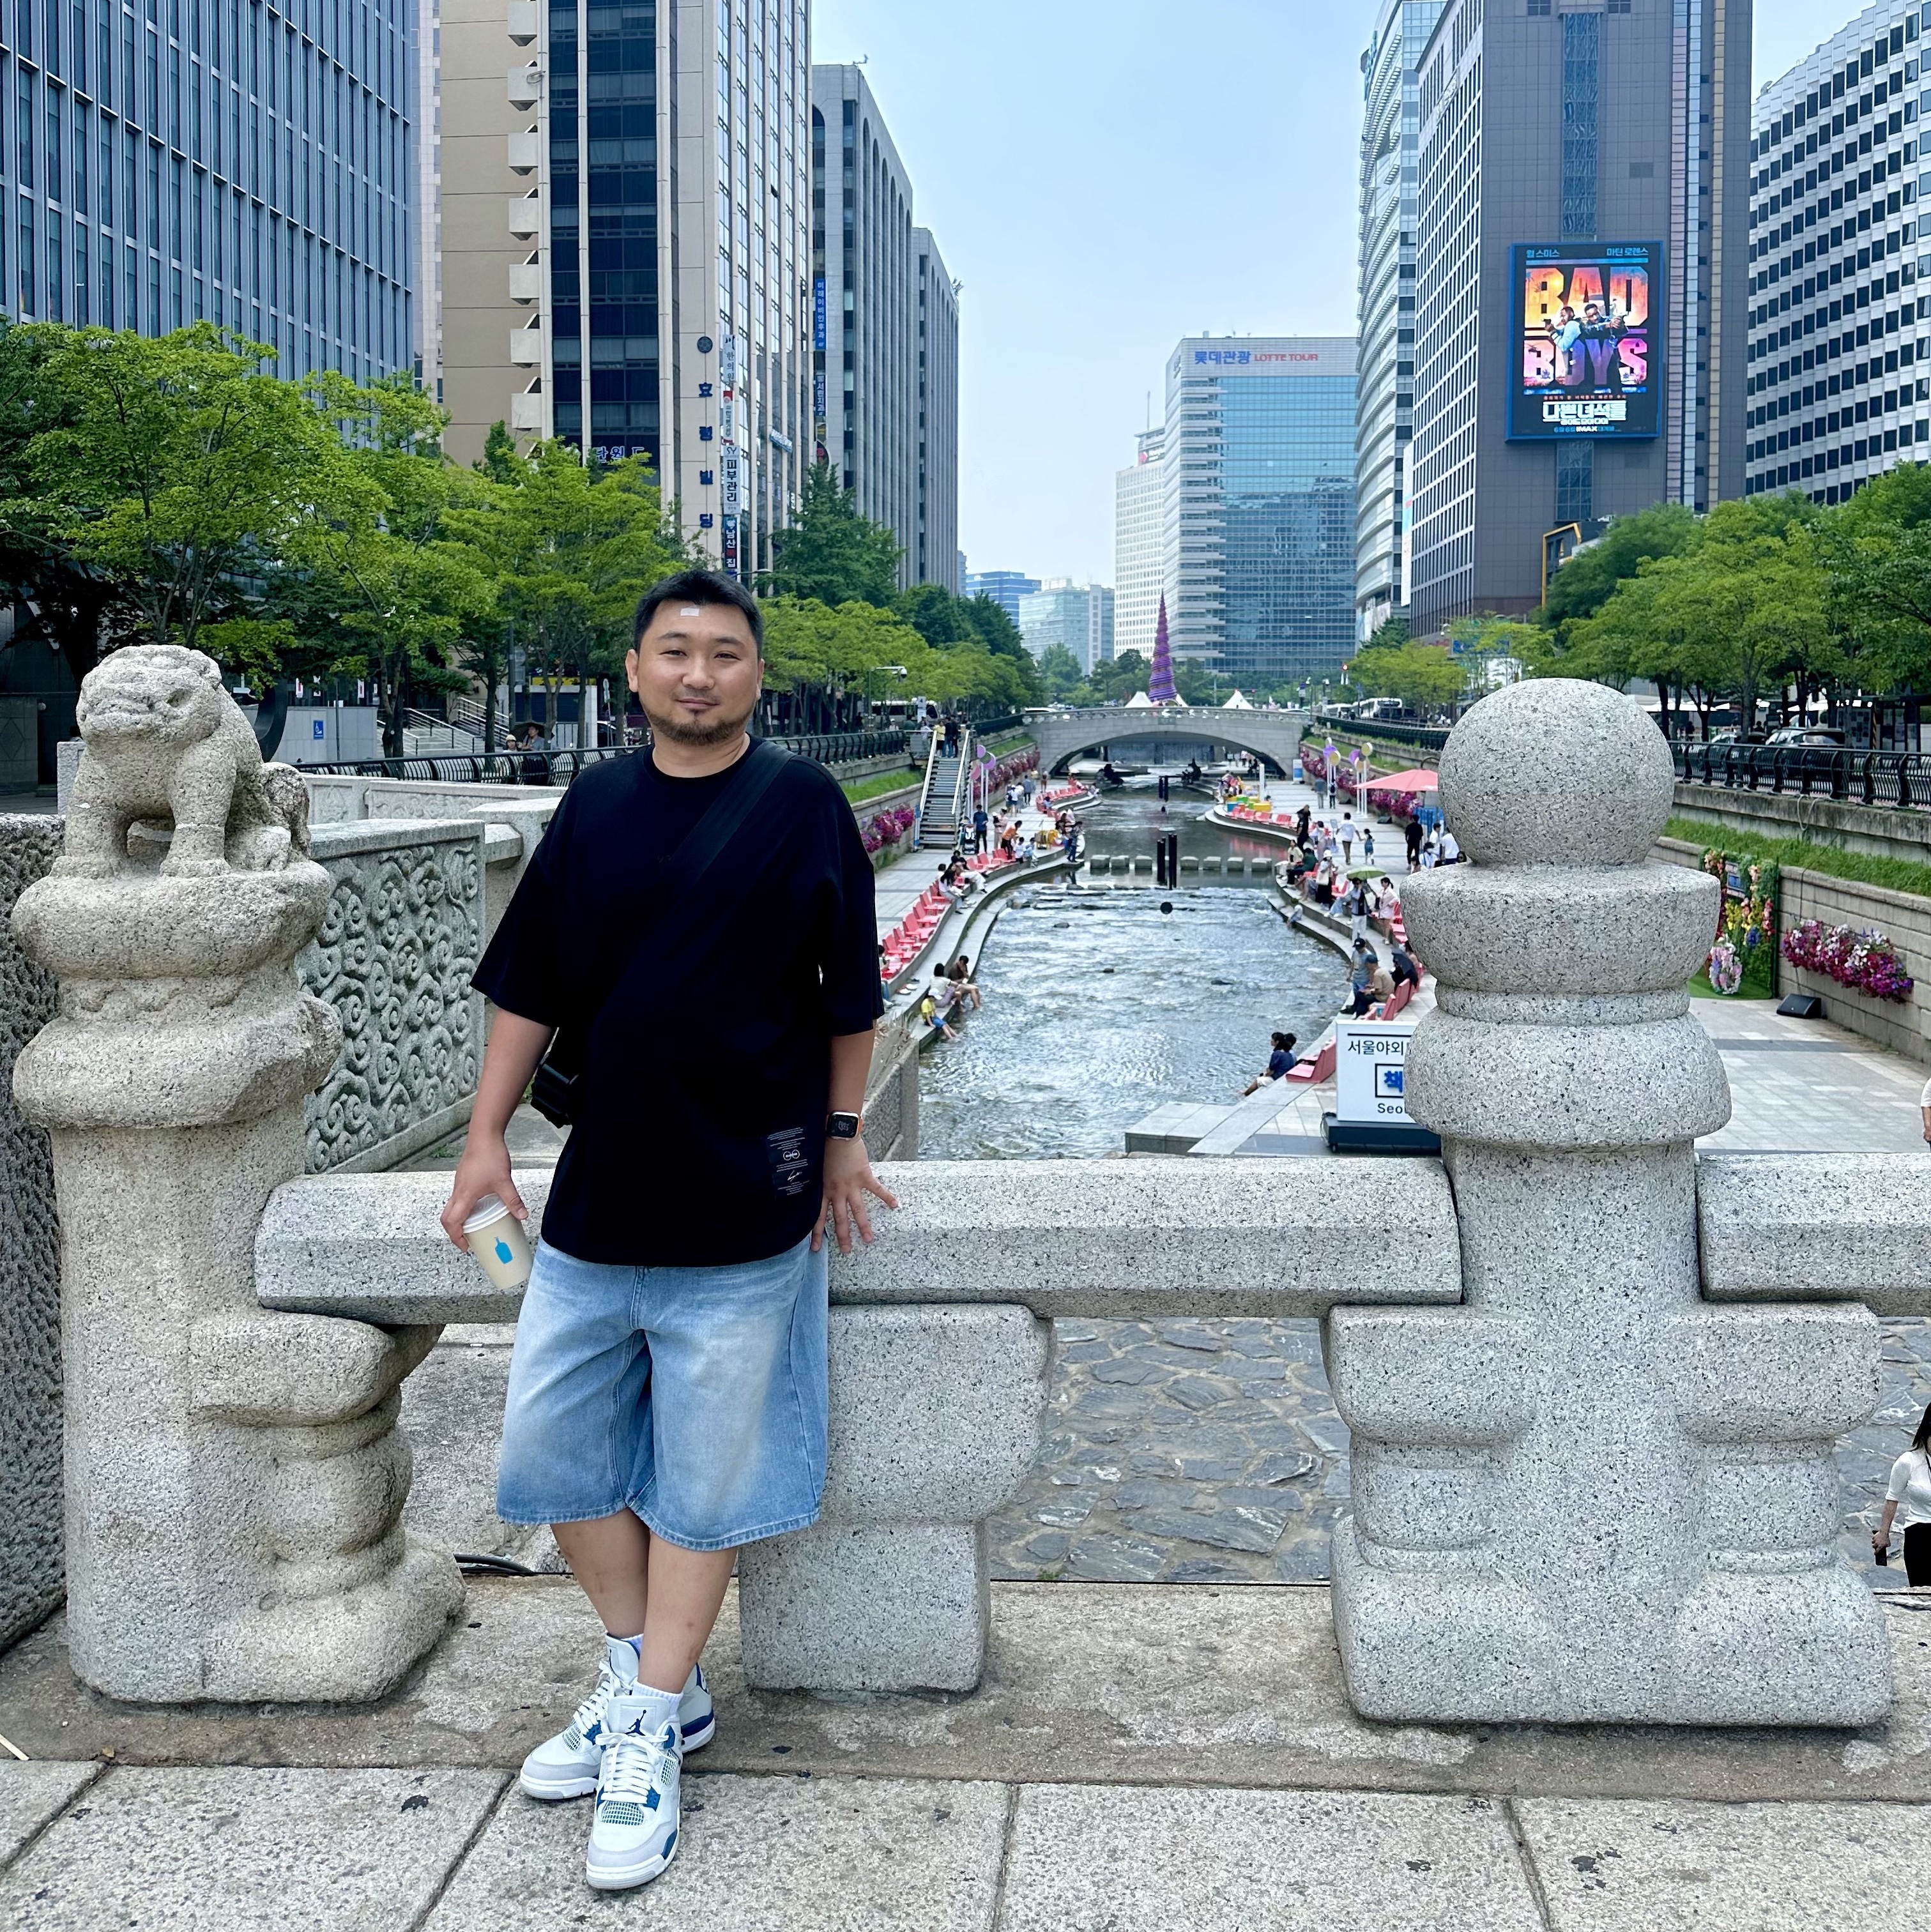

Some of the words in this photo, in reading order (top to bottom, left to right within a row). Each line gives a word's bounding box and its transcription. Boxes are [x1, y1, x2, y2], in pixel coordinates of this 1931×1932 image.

[1524, 266, 1648, 328] BAD
[1194, 350, 1251, 365] 롯데관광
[1523, 337, 1647, 386] BOYS
[726, 459, 737, 502] 피부관리
[1348, 1040, 1411, 1056] 서울야외
[1377, 1103, 1408, 1114] Seo
